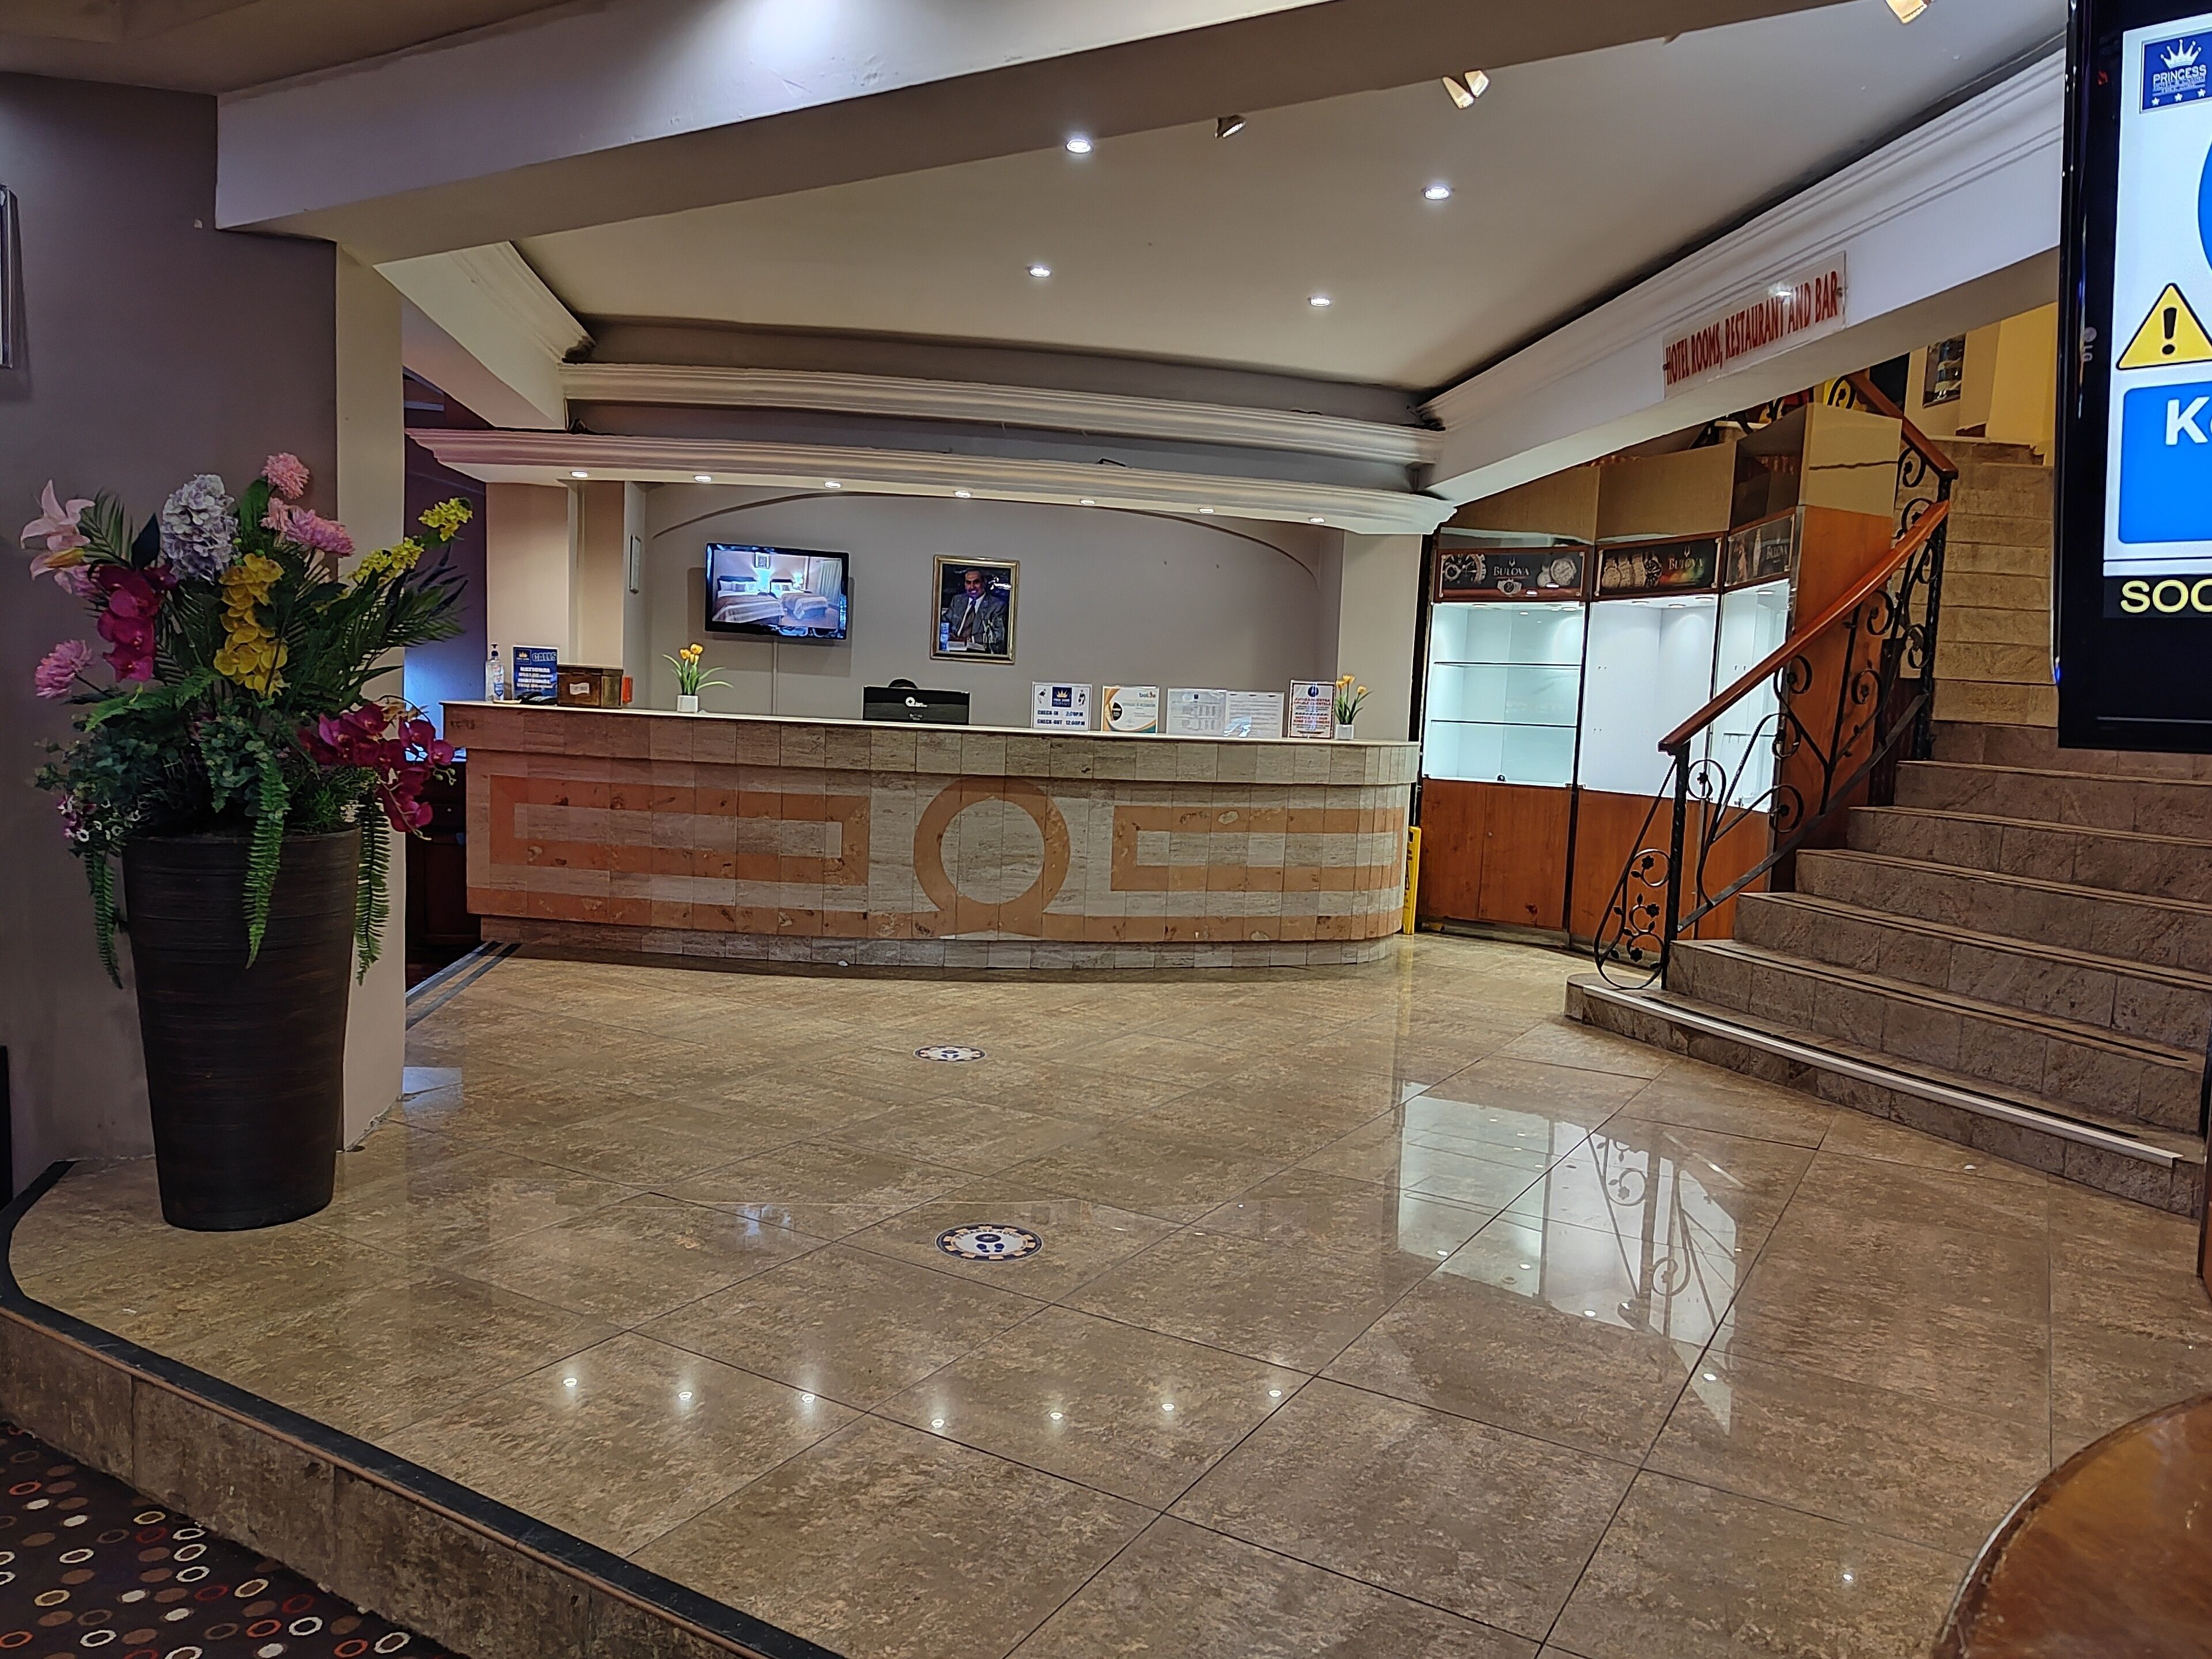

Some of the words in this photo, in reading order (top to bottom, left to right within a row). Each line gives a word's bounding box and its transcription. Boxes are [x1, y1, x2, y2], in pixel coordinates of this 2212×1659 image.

[2153, 64, 2207, 89] PRINCESS
[1665, 338, 1690, 386] HOTEL
[1691, 322, 1724, 373] ROOMS,
[1725, 296, 1785, 359] RESTAURANT
[1788, 282, 1811, 334] AND
[1815, 271, 1838, 324] BAR
[2165, 396, 2212, 445] K
[1494, 566, 1529, 576] BULOVA
[532, 652, 556, 662] CALLS
